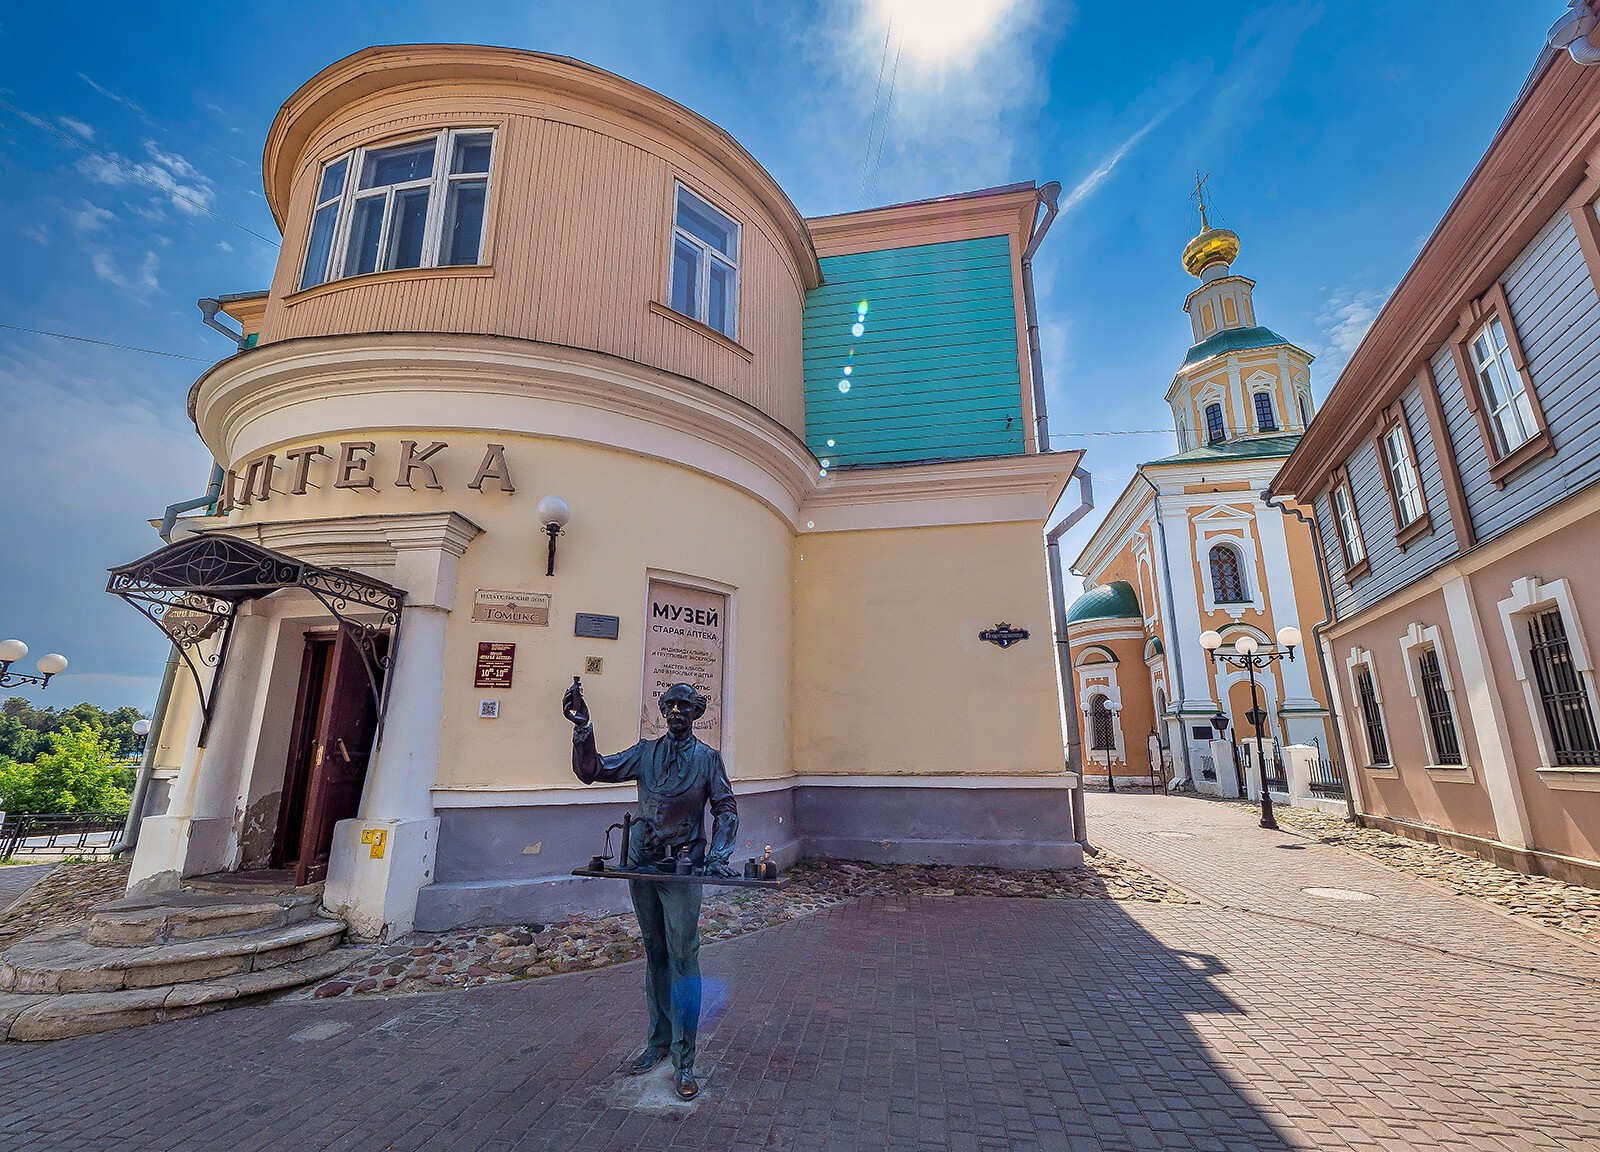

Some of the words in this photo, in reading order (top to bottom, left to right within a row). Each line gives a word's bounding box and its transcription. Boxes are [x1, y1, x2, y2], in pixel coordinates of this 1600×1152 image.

[214, 439, 516, 517] АПТЕКА
[652, 602, 718, 628] МУЗЕЙ
[652, 624, 685, 637] СТАРАЯ
[686, 628, 718, 641] АПТЕКА
